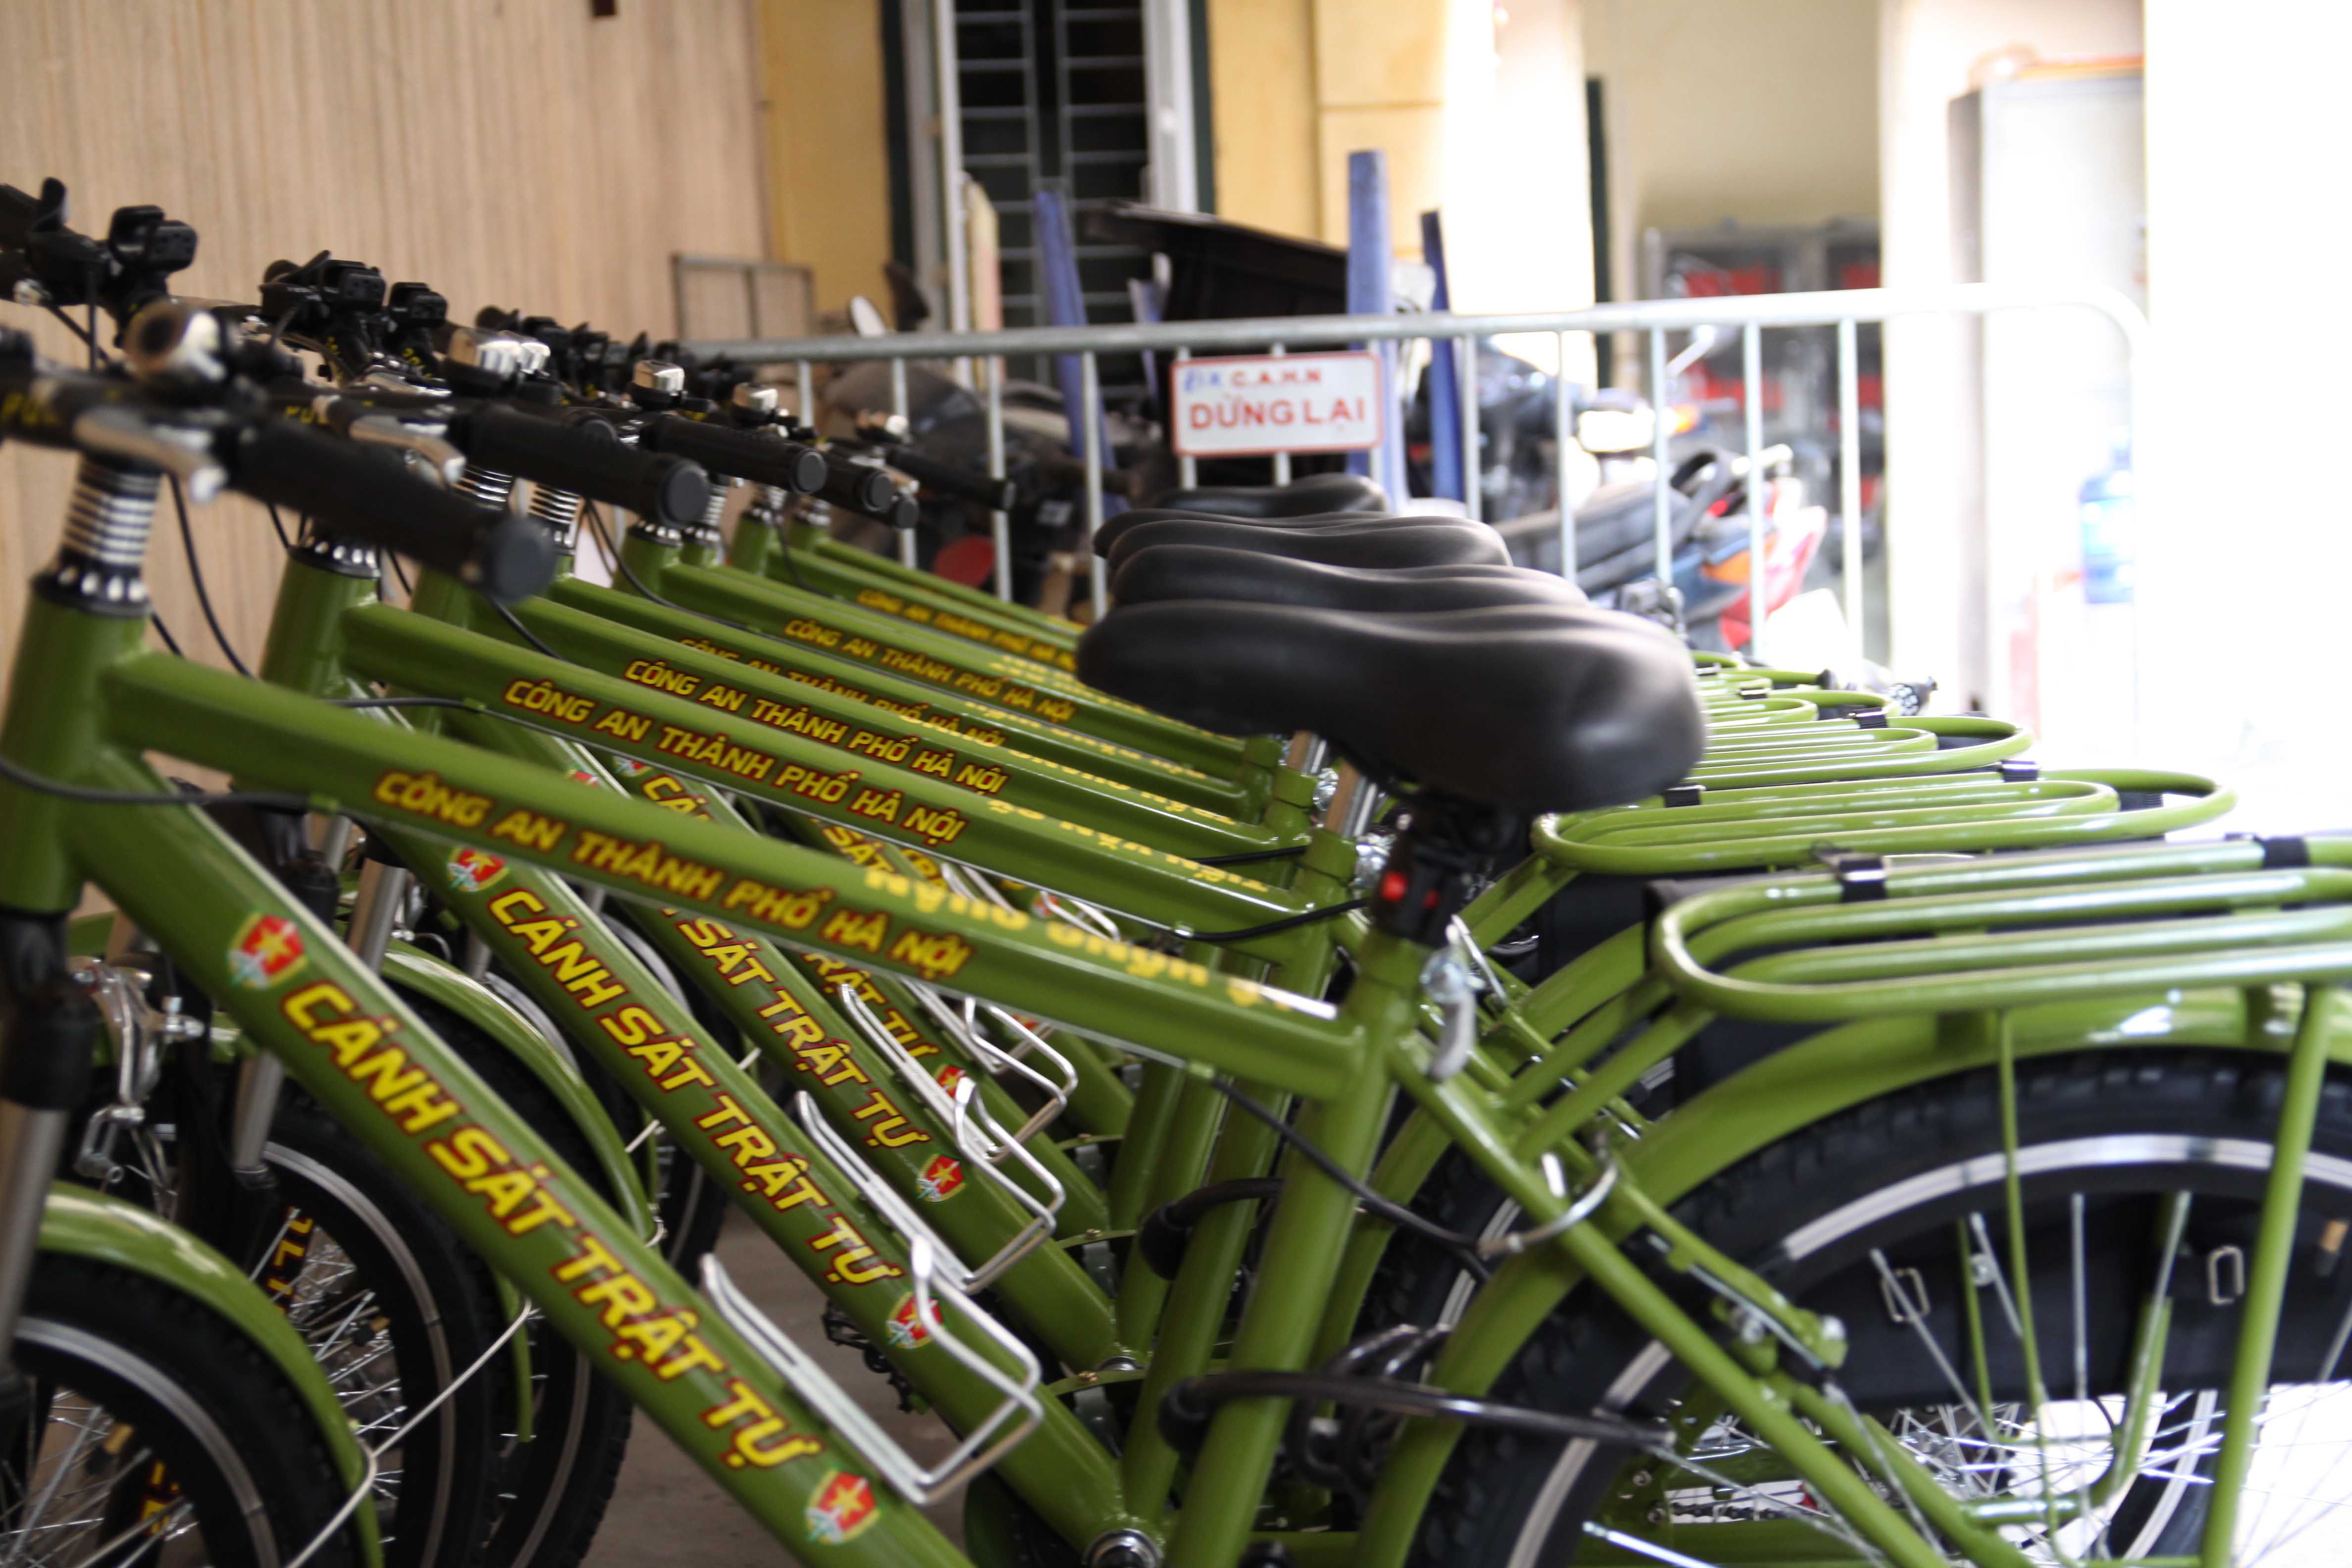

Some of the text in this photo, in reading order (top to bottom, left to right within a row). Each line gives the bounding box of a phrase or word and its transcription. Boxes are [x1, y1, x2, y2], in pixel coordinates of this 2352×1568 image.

[624, 659, 702, 696] CÔNG
[698, 684, 747, 713] AN
[847, 735, 920, 763] PHỐ
[955, 763, 1009, 796] NỘI
[784, 619, 841, 647] CÔNG
[839, 637, 878, 659] AN
[503, 678, 595, 723] CÔNG
[594, 709, 651, 742] AN
[774, 765, 861, 803] PHỐ
[902, 806, 968, 846] NỘI
[374, 769, 492, 828] CÔNG
[491, 809, 567, 852] AN
[722, 884, 833, 931] PHỐ
[888, 929, 973, 980] NỘI
[676, 916, 933, 1150] SÁT TRẬT TỰ
[595, 1003, 718, 1093] SÁT
[694, 1091, 832, 1213] TRẬT
[807, 1213, 907, 1286] TỰ
[425, 1127, 576, 1237] SÁT
[552, 1234, 727, 1381] TRẬT
[703, 1378, 824, 1469] TỰ
